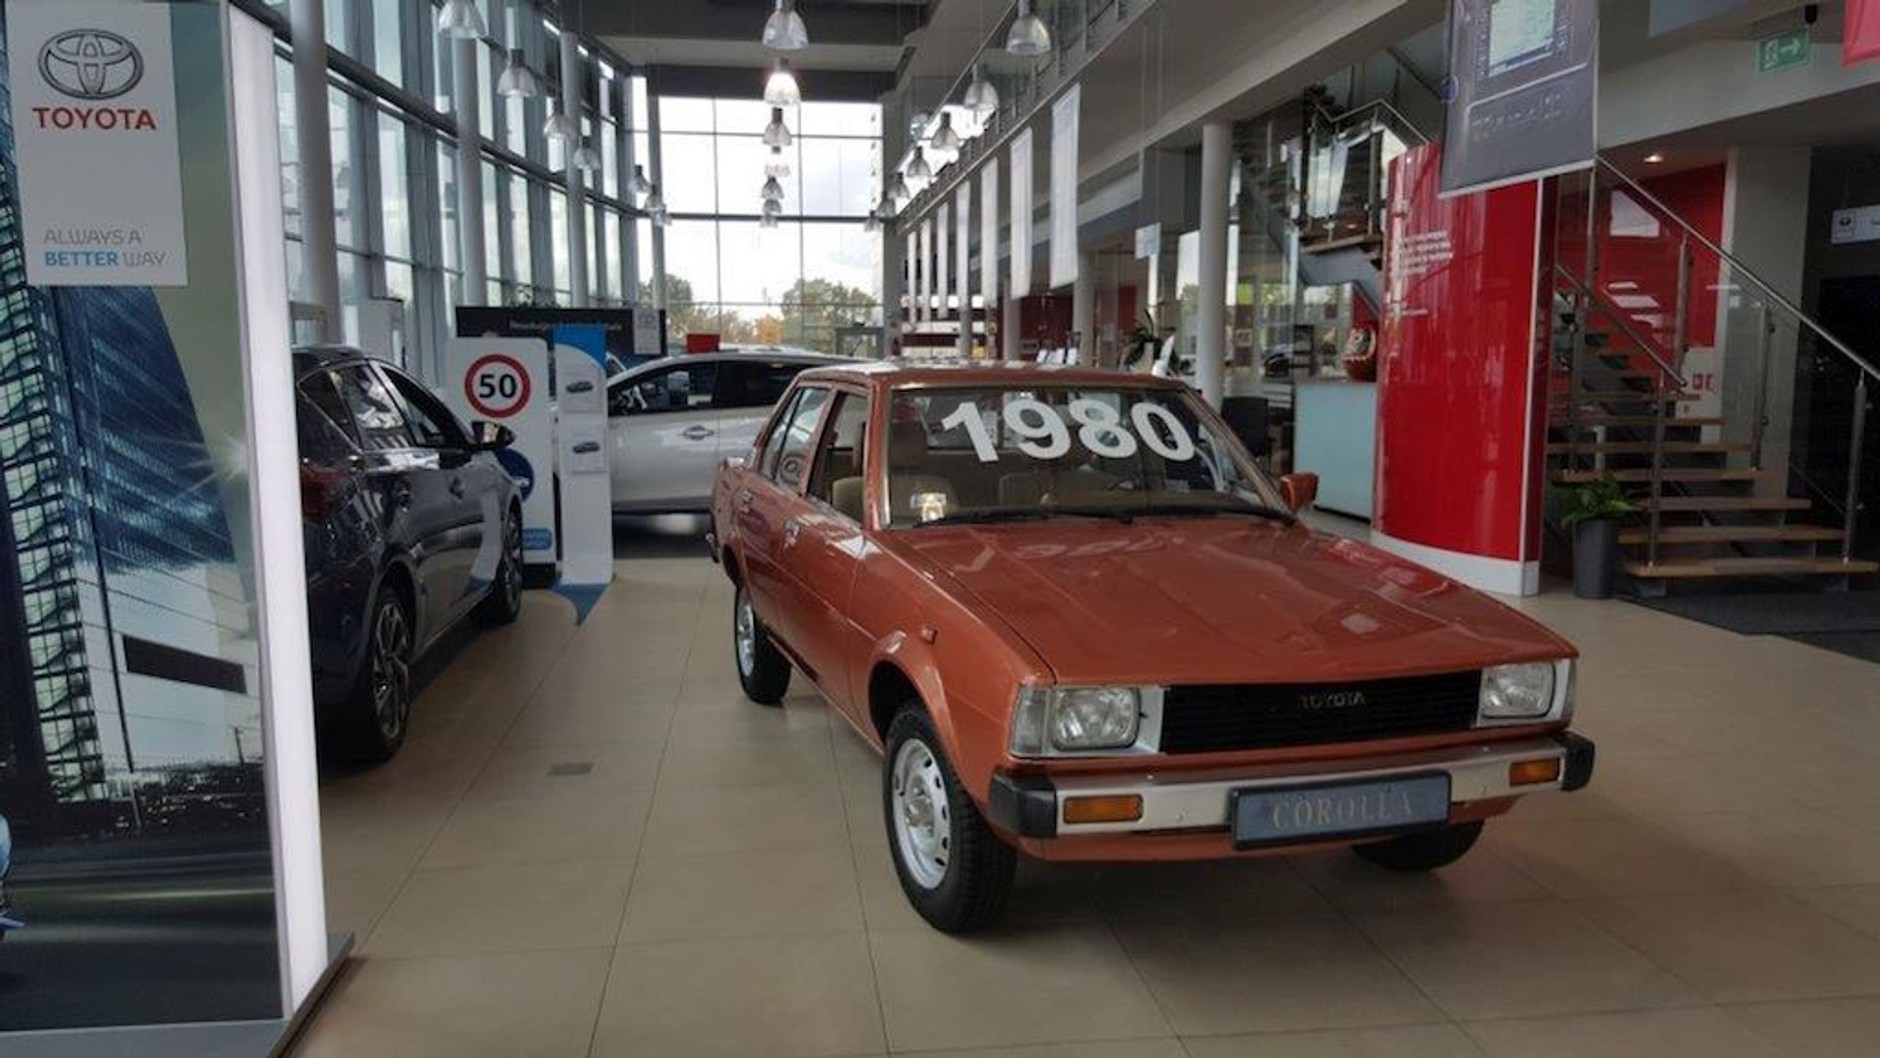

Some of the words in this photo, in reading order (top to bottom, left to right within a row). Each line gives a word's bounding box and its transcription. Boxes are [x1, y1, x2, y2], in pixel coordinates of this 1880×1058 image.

[33, 107, 156, 130] TOYOTA
[44, 229, 121, 246] ALWAYS
[128, 230, 142, 245] A
[45, 251, 118, 267] BETTER
[122, 251, 166, 267] WAY
[479, 374, 517, 398] 50
[941, 400, 1195, 462] 1980
[1273, 790, 1413, 829] COROLLA
